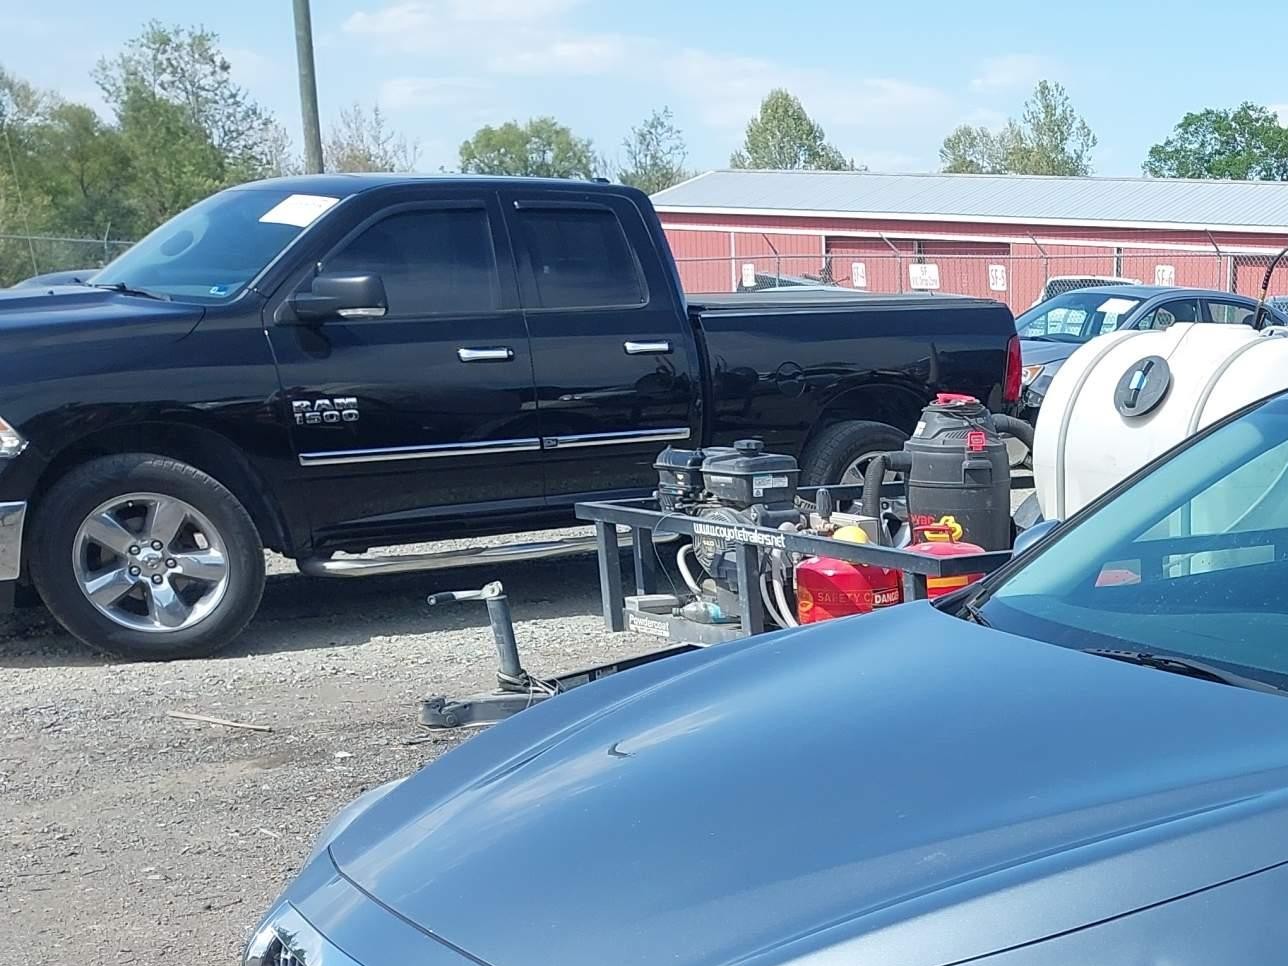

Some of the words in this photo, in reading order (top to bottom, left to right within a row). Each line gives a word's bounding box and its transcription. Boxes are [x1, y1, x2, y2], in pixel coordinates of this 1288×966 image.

[990, 268, 1005, 287] SF-5
[292, 397, 358, 412] RAM
[294, 410, 360, 424] 1500
